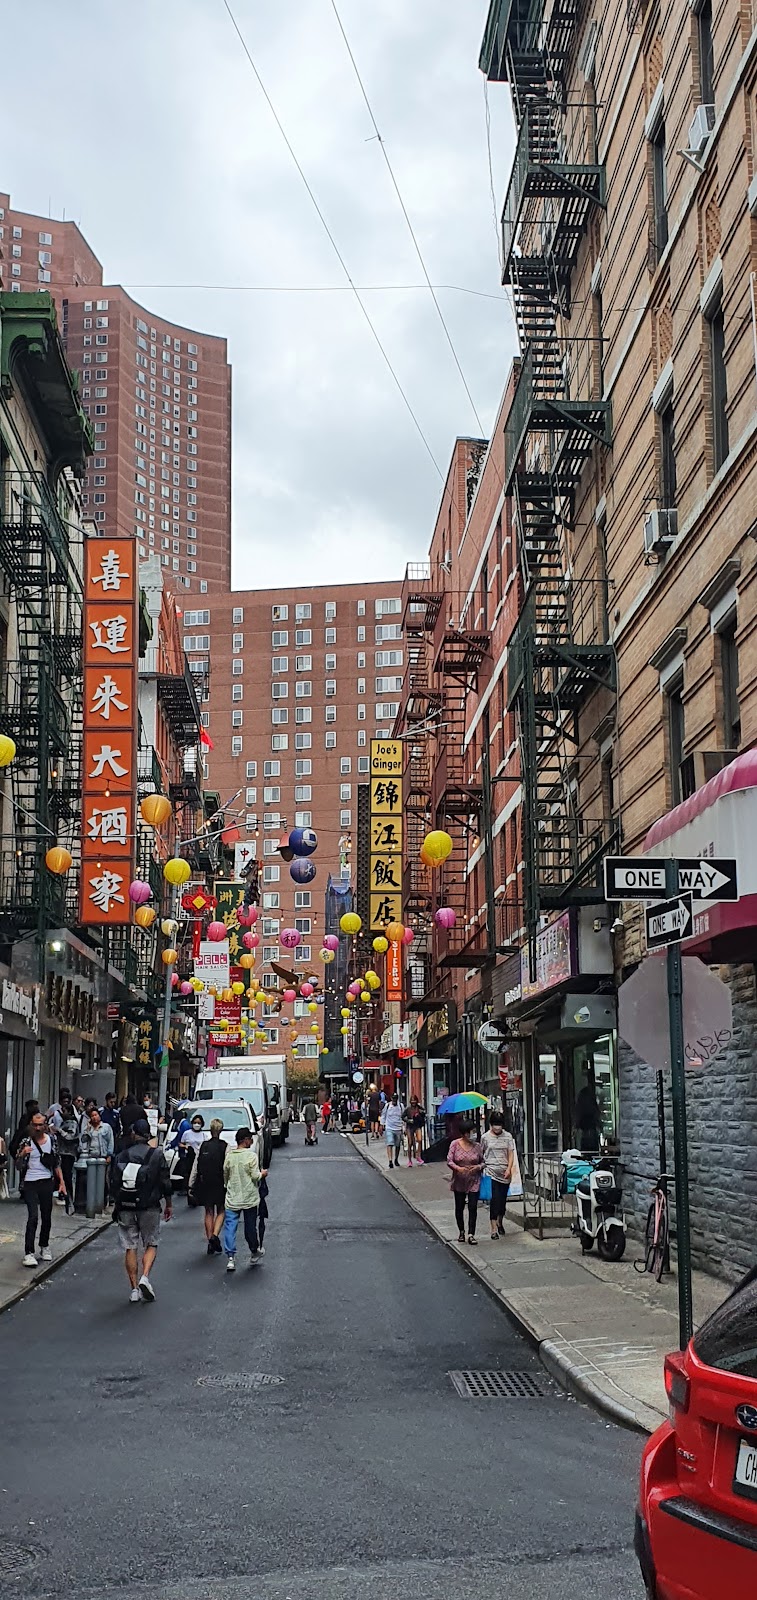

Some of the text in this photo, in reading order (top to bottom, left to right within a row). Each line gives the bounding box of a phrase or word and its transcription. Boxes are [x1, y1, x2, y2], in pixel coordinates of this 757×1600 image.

[88, 549, 130, 912] 喜運來大酒家
[376, 743, 397, 755] Joe's
[372, 757, 401, 771] Ginger
[372, 780, 400, 924] 錦江飯店
[625, 871, 717, 888] ONE WAY
[652, 908, 686, 934] ONE WAY
